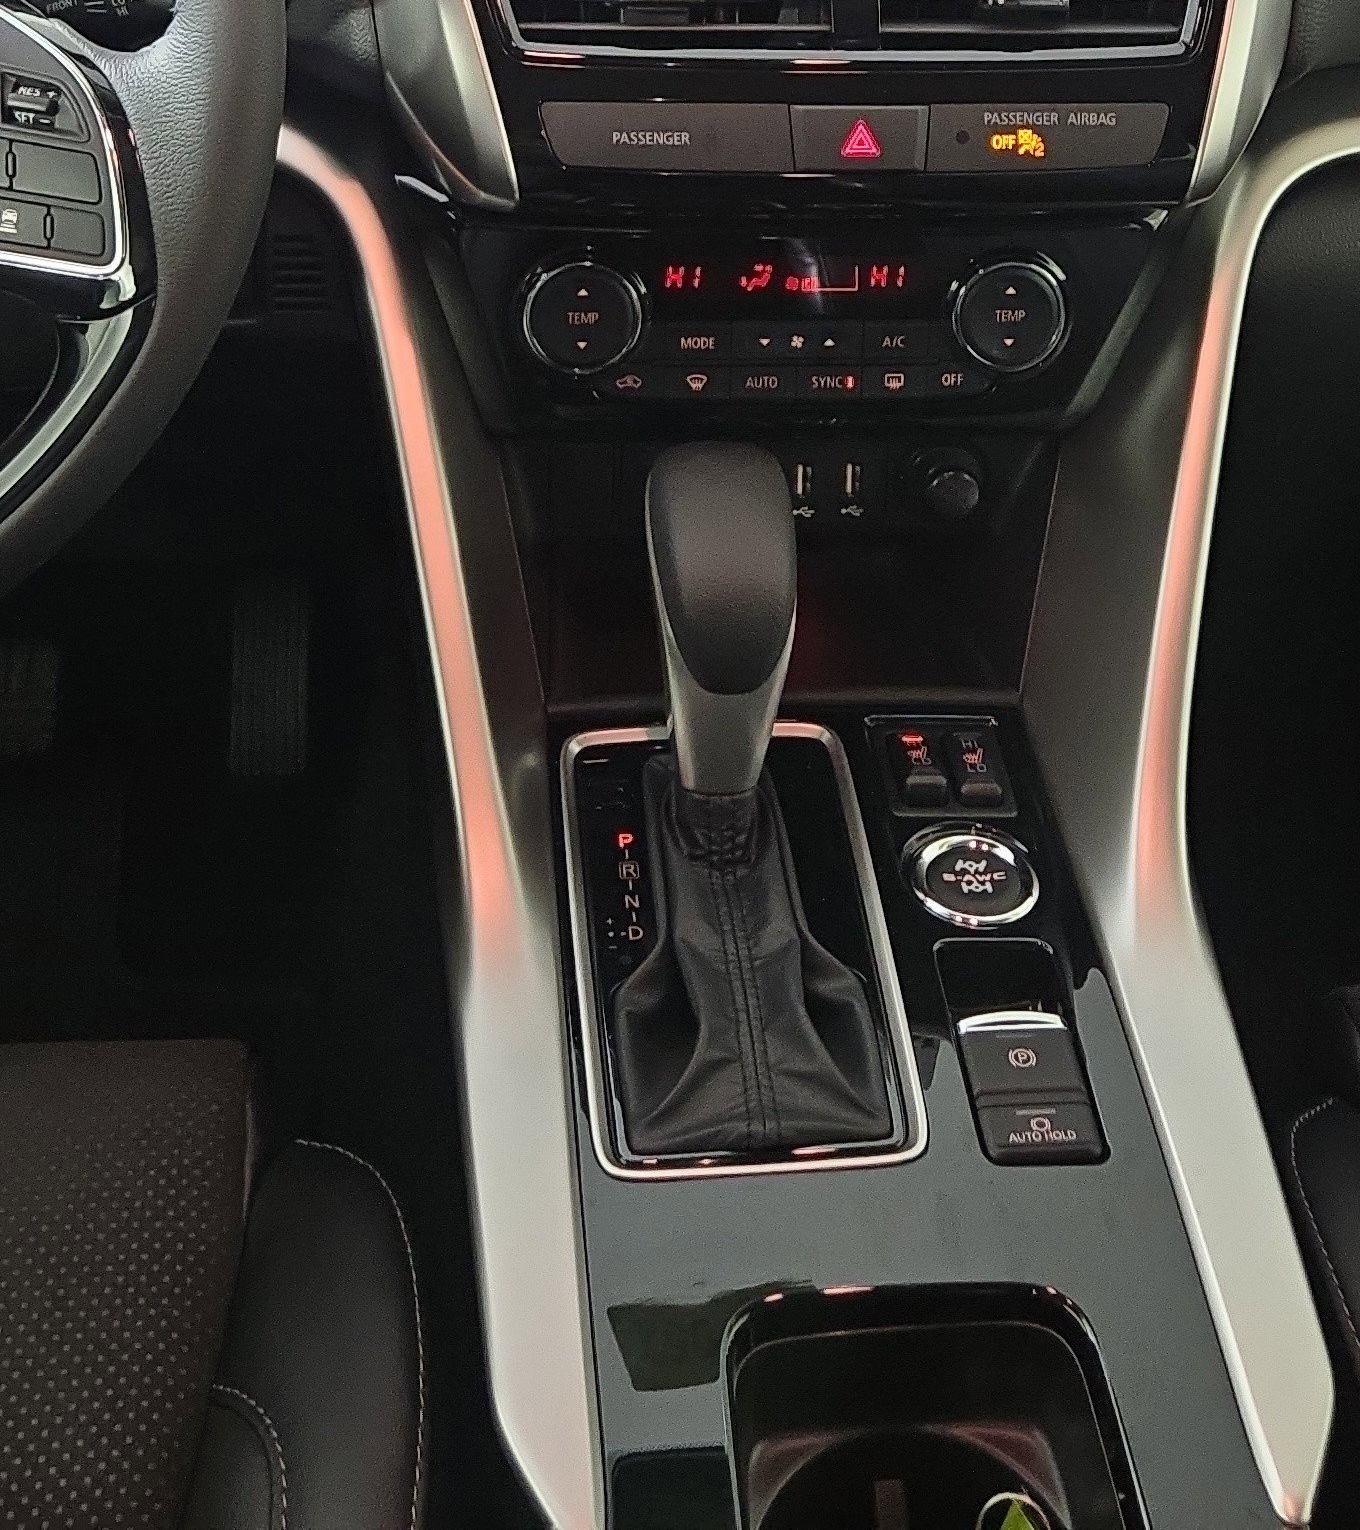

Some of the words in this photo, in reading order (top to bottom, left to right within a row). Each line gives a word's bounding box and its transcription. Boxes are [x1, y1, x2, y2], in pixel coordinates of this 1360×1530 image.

[984, 112, 1059, 126] PASSENGER
[1067, 112, 1116, 126] AIRBAG
[612, 130, 690, 146] PASSENGER
[992, 134, 1016, 150] OFF
[567, 312, 599, 324] TEMP
[995, 310, 1026, 322] TEMP
[680, 337, 715, 349] MODE
[882, 336, 906, 348] A/C
[745, 376, 778, 389] AUTO
[812, 376, 843, 389] SYNC
[942, 373, 964, 386] OFF
[618, 833, 633, 848] P
[622, 865, 637, 877] R
[624, 895, 640, 908] N
[628, 926, 643, 941] D
[1009, 1131, 1042, 1142] AUTO
